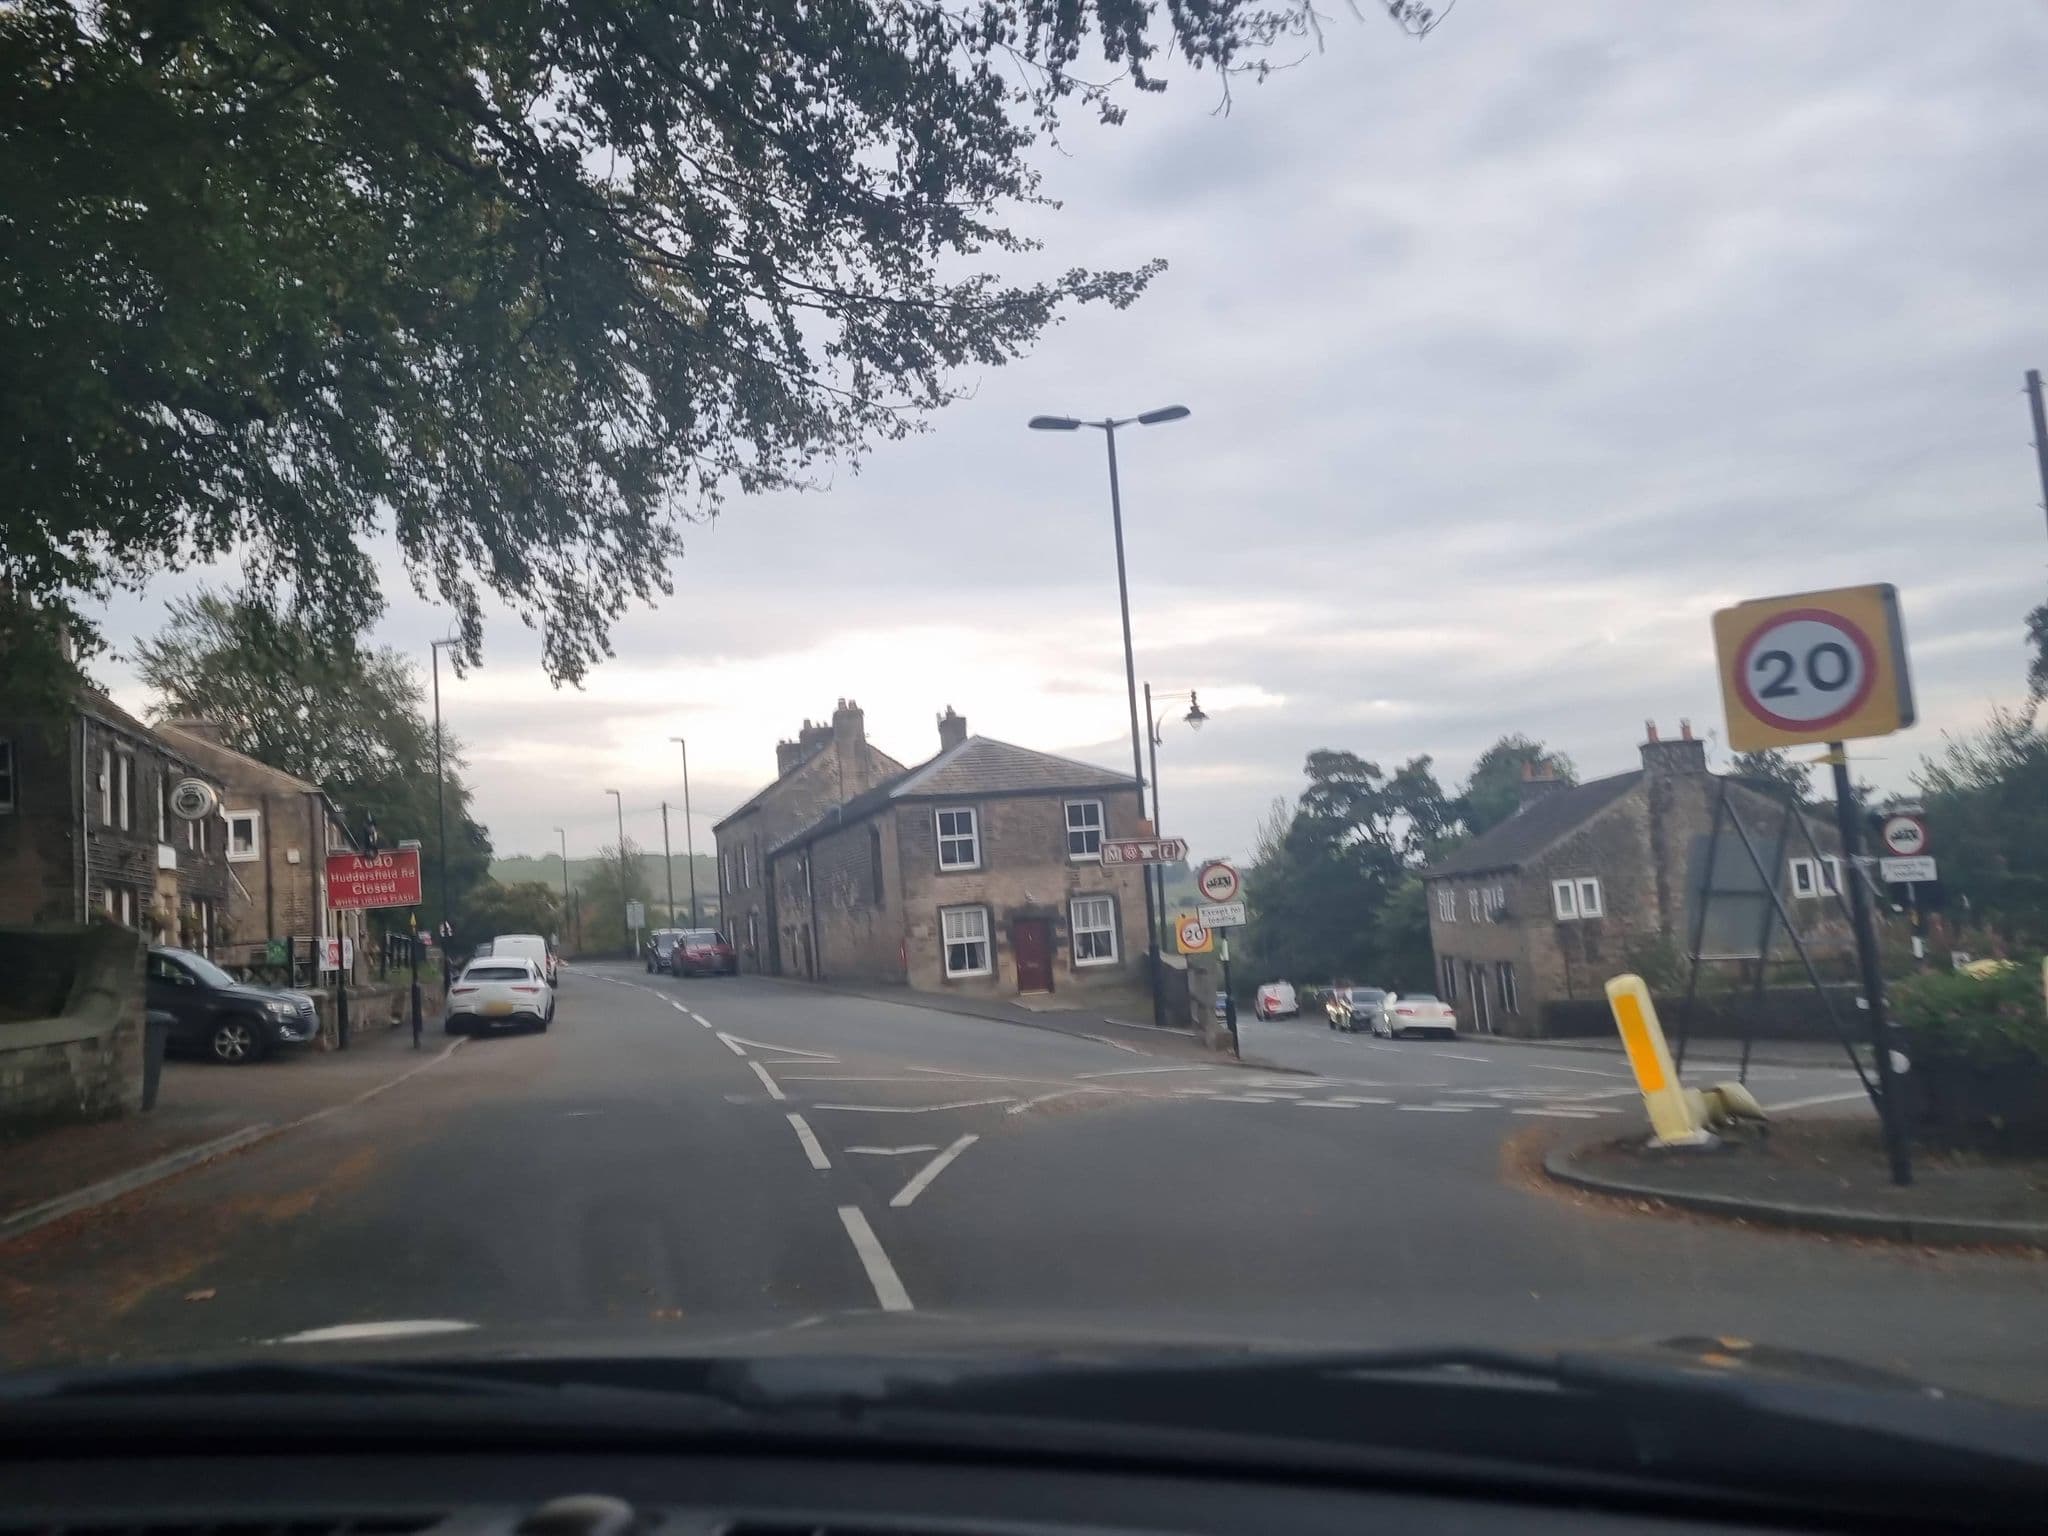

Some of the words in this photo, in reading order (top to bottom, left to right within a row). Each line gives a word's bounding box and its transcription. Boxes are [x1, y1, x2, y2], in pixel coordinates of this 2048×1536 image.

[1754, 641, 1853, 700] 20
[331, 870, 397, 882] Huddersfield
[401, 868, 415, 878] Rd
[352, 880, 395, 895] Closed
[1185, 927, 1204, 941] 20
